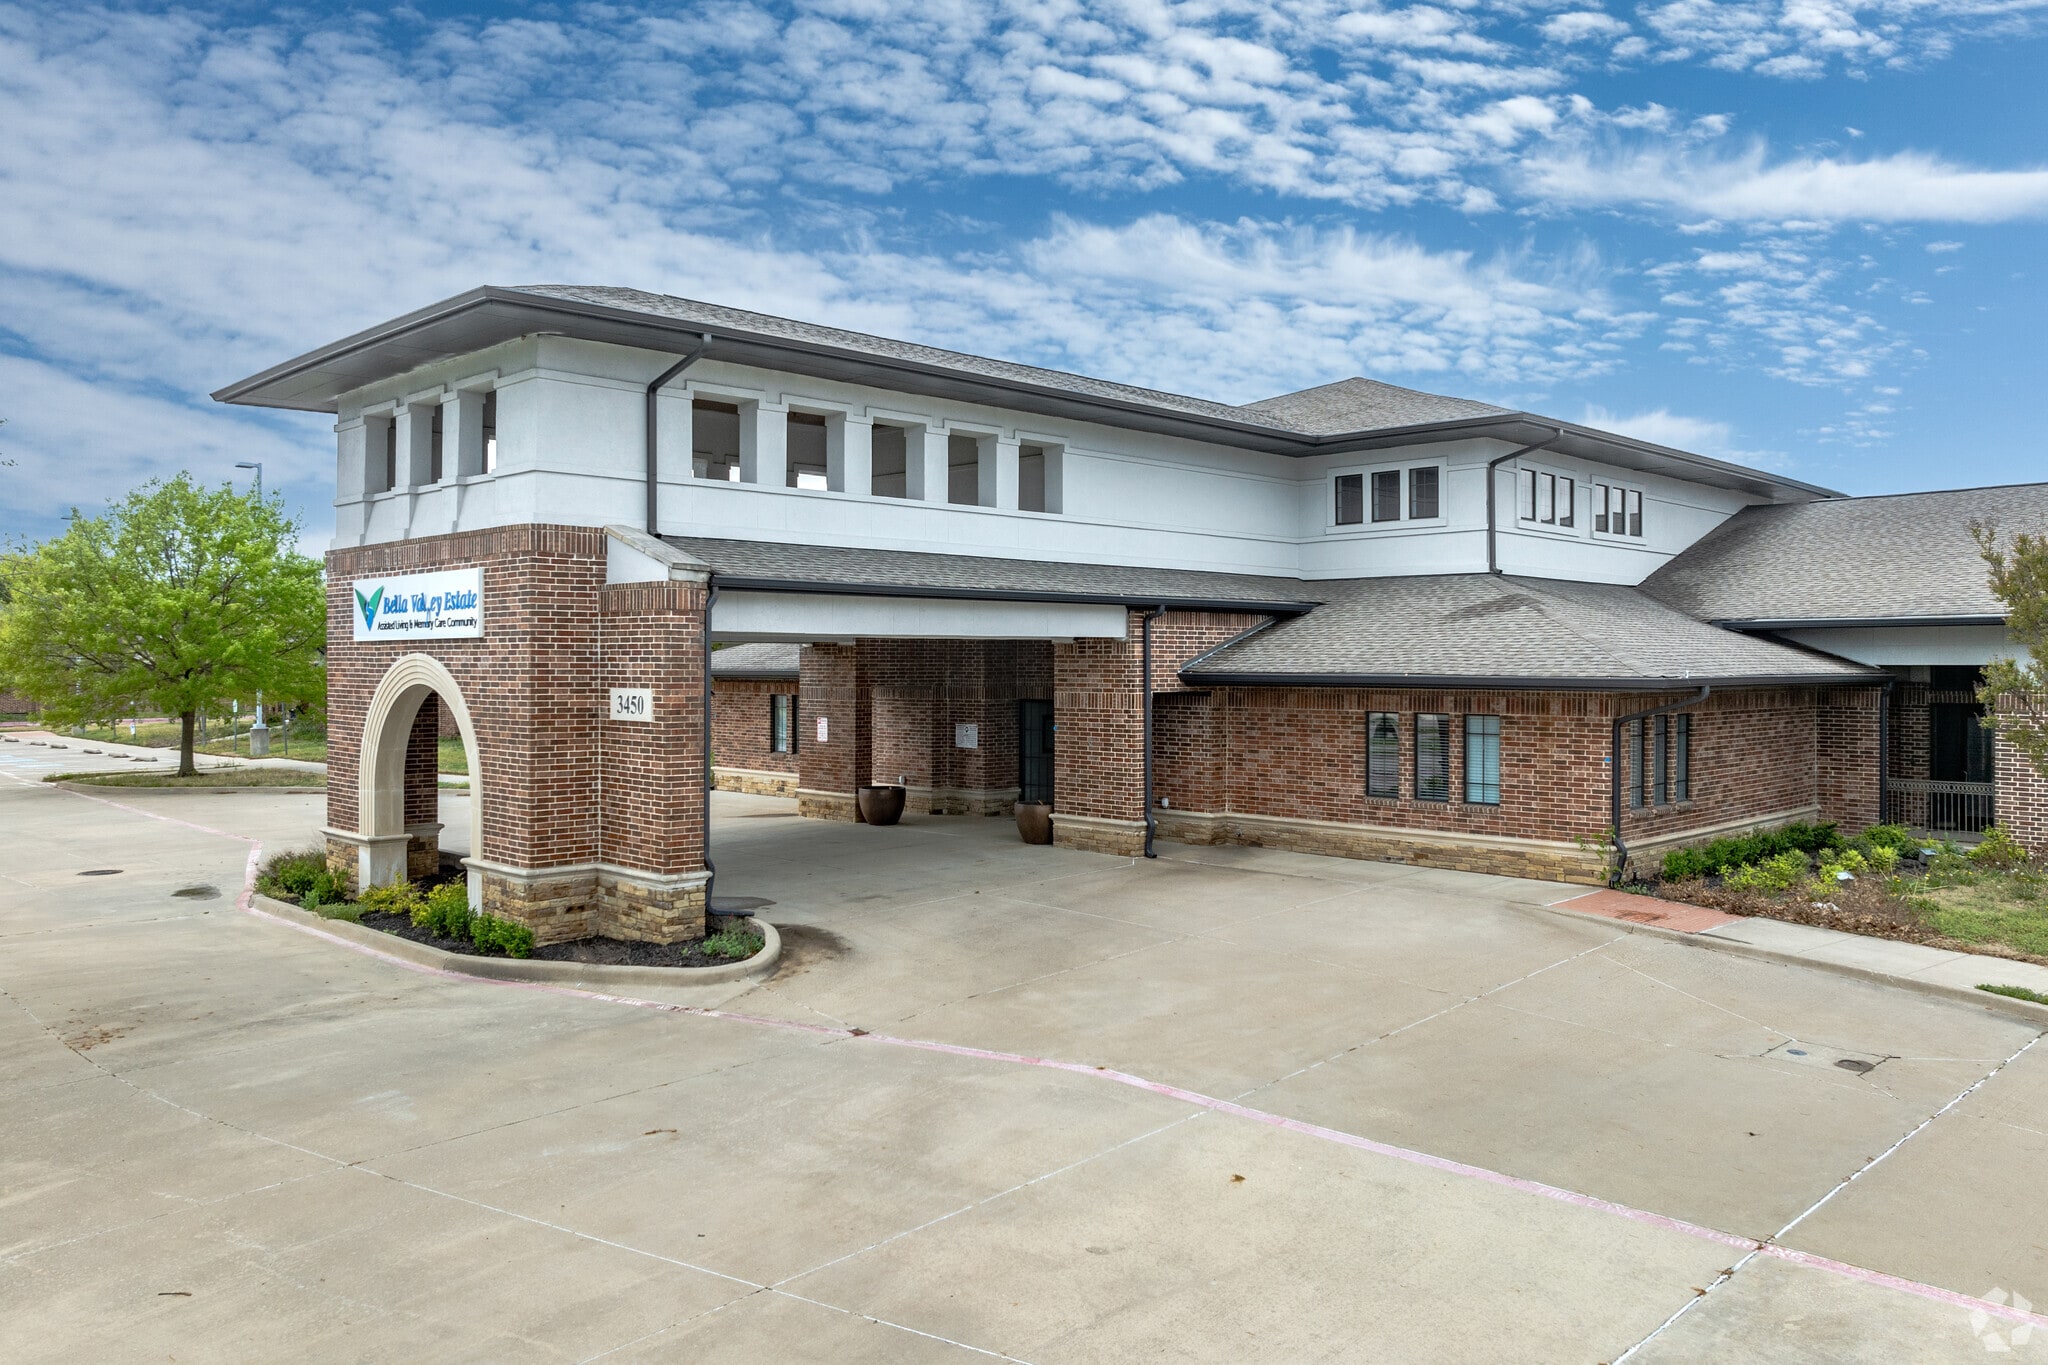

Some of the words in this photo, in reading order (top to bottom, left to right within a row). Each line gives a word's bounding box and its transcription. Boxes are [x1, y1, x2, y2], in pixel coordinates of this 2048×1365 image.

[383, 594, 408, 615] Bella
[410, 592, 442, 617] Valey
[443, 589, 478, 611] Estate
[377, 620, 395, 631] Assisted
[395, 620, 409, 632] Living
[413, 619, 434, 631] Memory
[434, 617, 447, 629] Care
[446, 616, 478, 629] Community
[616, 694, 645, 715] 3450
